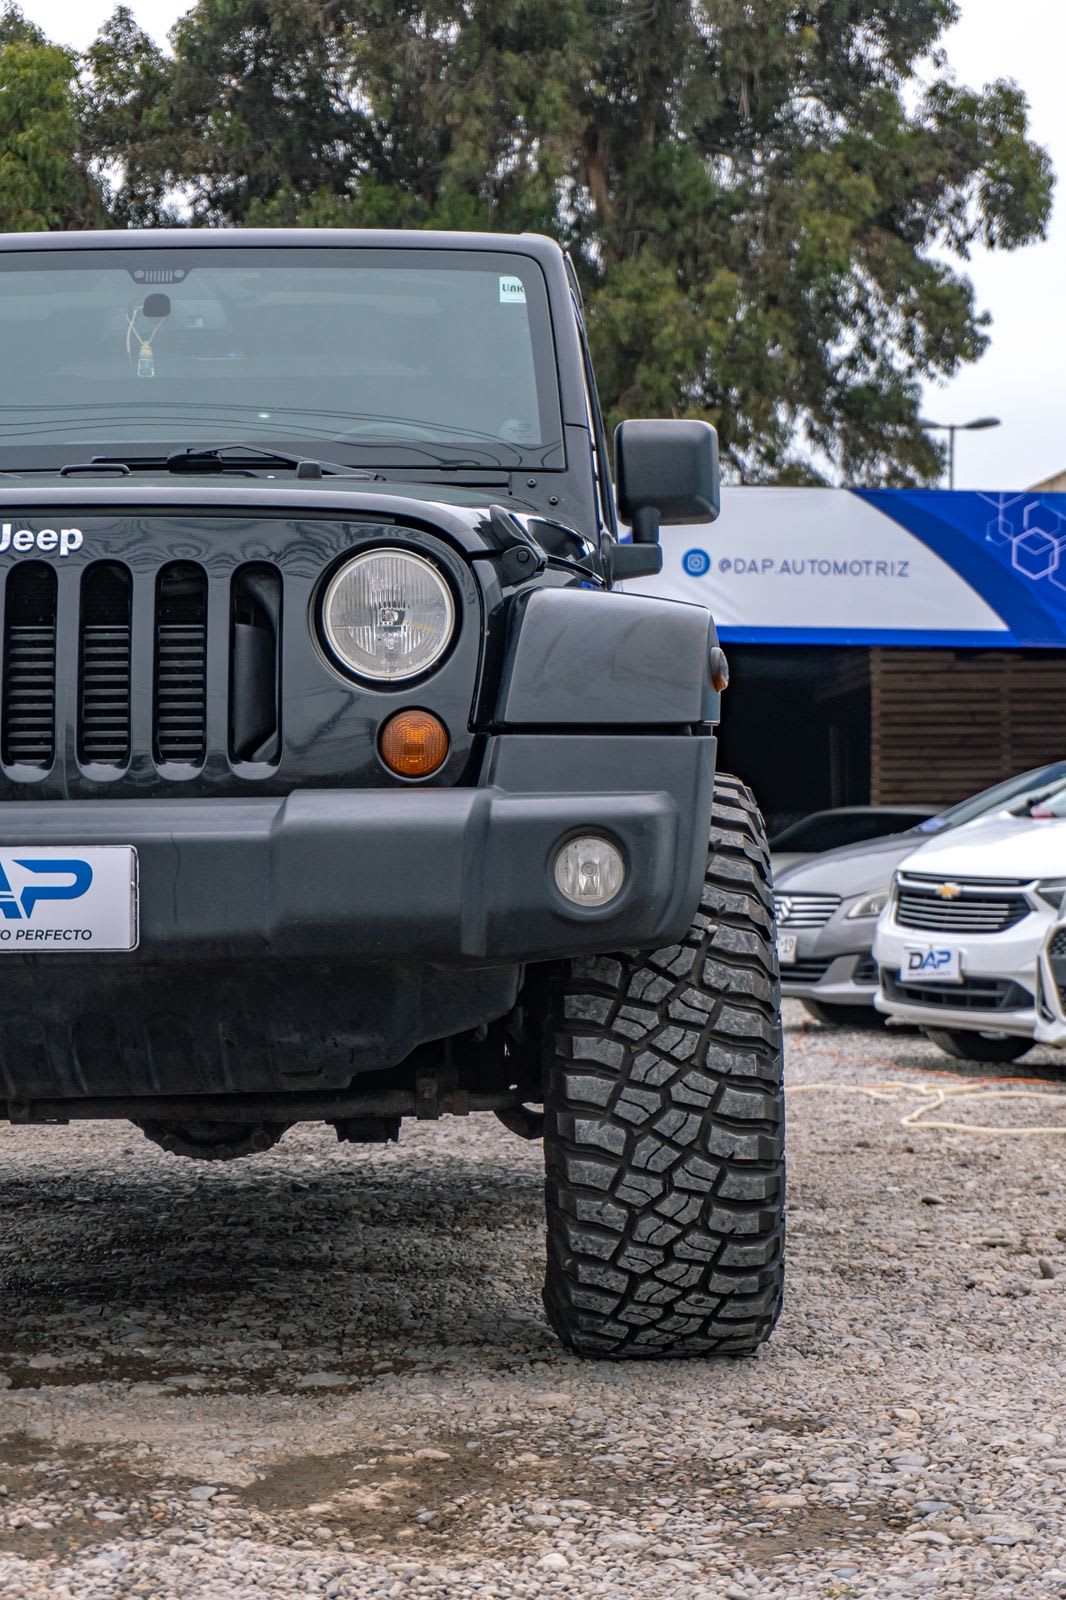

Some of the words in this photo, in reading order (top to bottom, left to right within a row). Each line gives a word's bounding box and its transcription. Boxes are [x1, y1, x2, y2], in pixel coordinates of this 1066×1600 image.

[0, 523, 84, 557] Jeep
[718, 557, 909, 578] @DAP.AUTOMOTRIZ
[15, 929, 93, 941] PERFECTO
[908, 950, 952, 970] DAP
